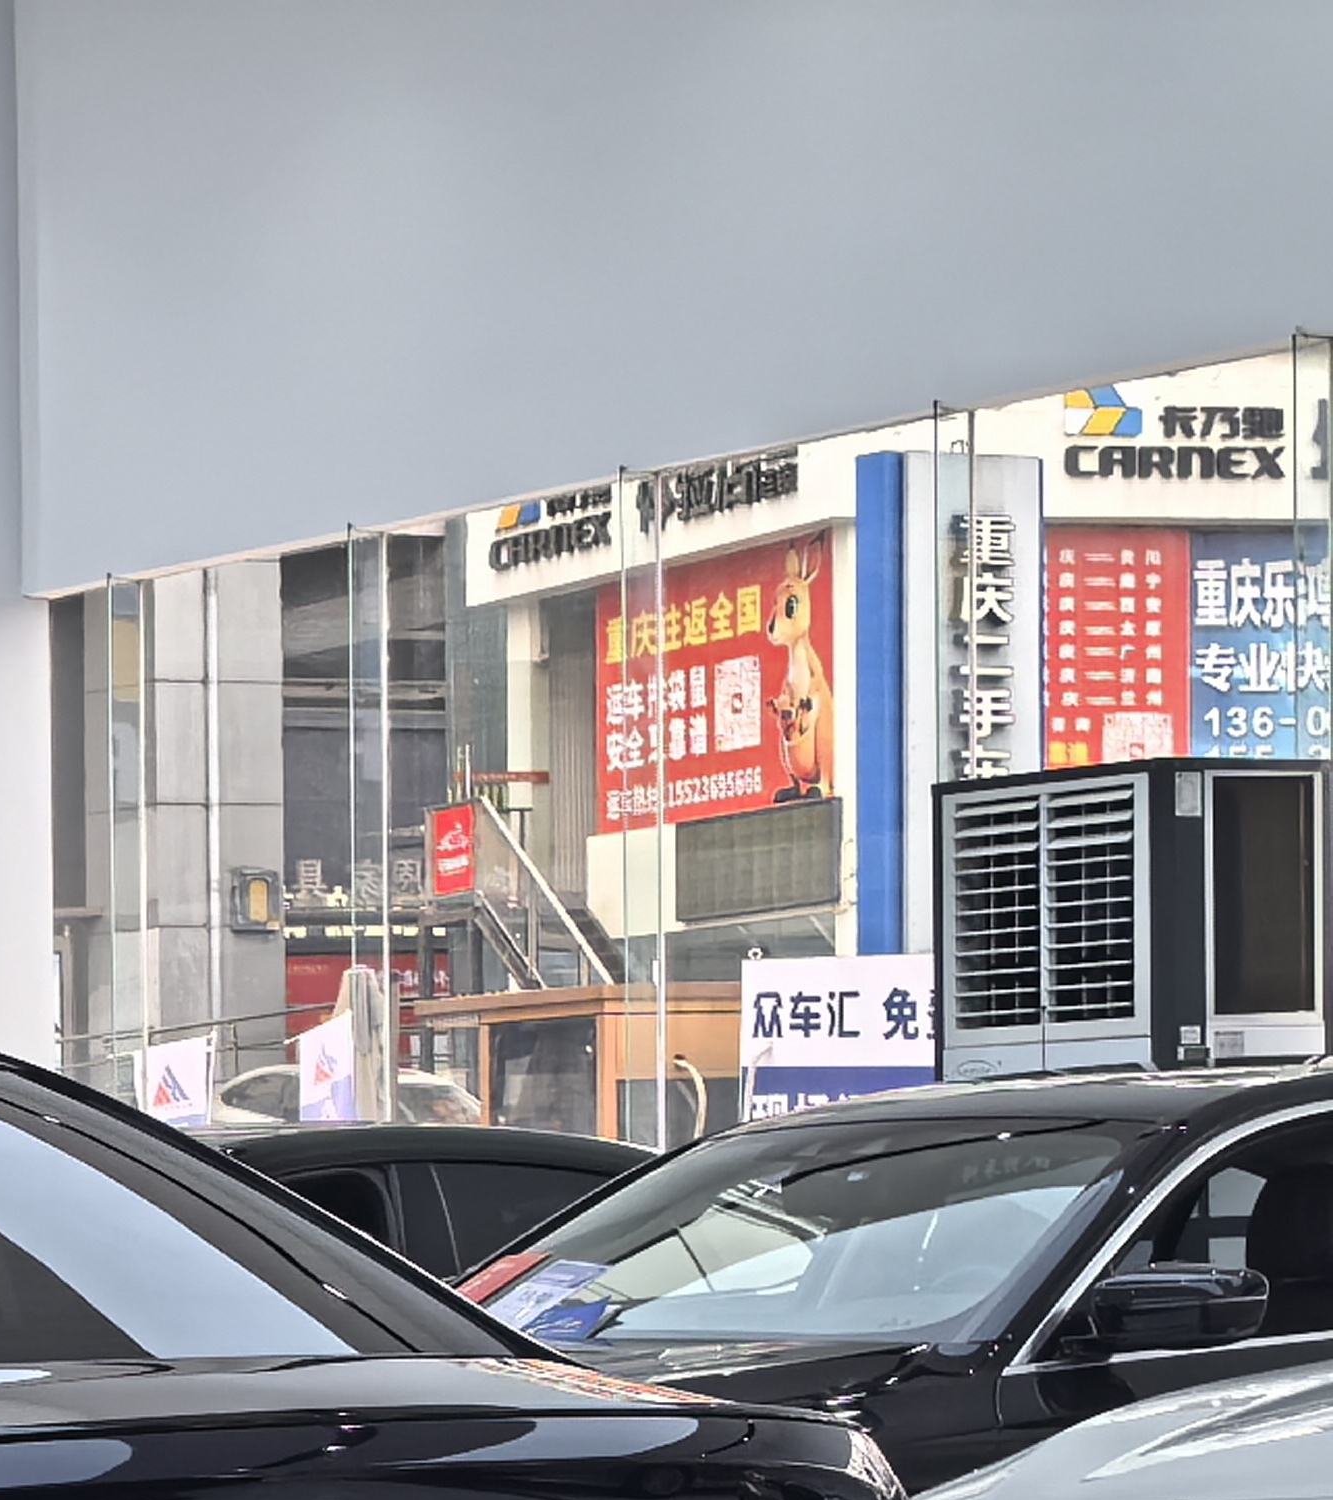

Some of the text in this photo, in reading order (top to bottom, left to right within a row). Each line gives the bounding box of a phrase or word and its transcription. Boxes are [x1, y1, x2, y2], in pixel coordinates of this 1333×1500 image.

[1064, 445, 1286, 480] CARNEX
[753, 987, 935, 1041] 众车汇 免
